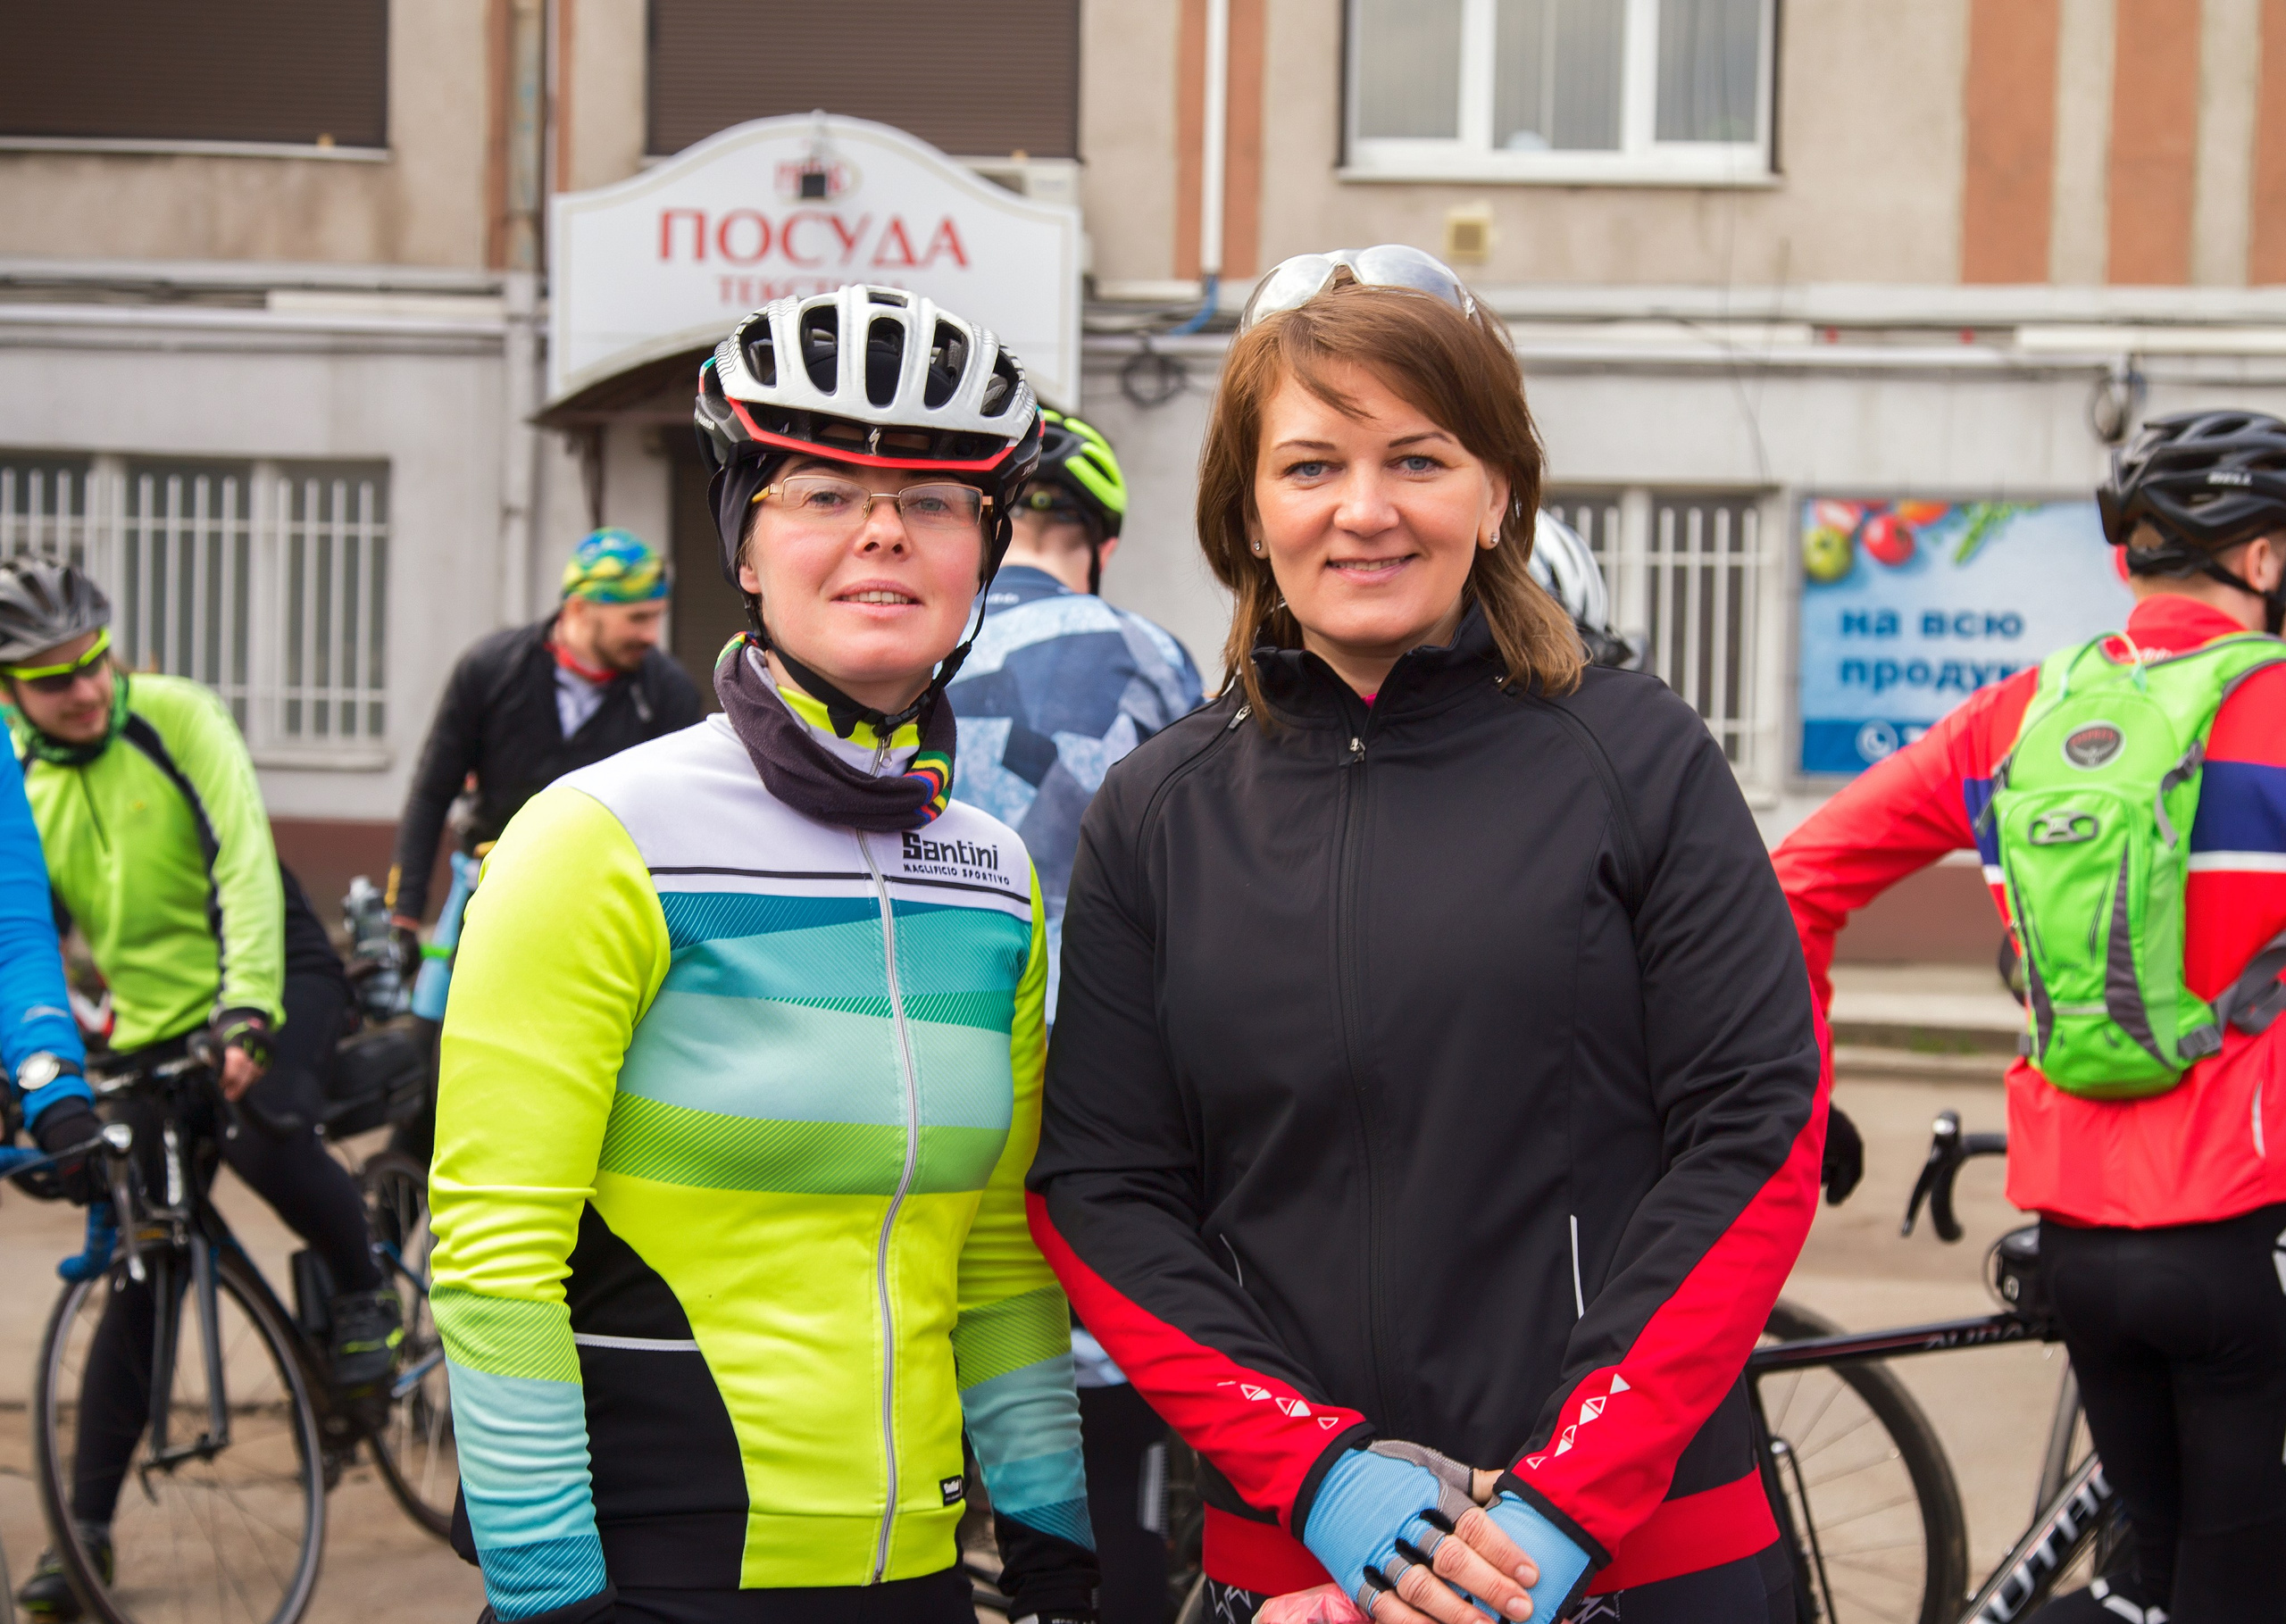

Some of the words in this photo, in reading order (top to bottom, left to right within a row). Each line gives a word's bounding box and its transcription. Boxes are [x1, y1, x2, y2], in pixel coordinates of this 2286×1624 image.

[658, 206, 971, 269] ПОСУДА
[1840, 609, 1900, 640] на
[1920, 609, 2025, 640] всю
[901, 830, 998, 870] Santini
[903, 862, 958, 876] MAGLIFICIO
[962, 868, 1010, 886] SPORTIVO
